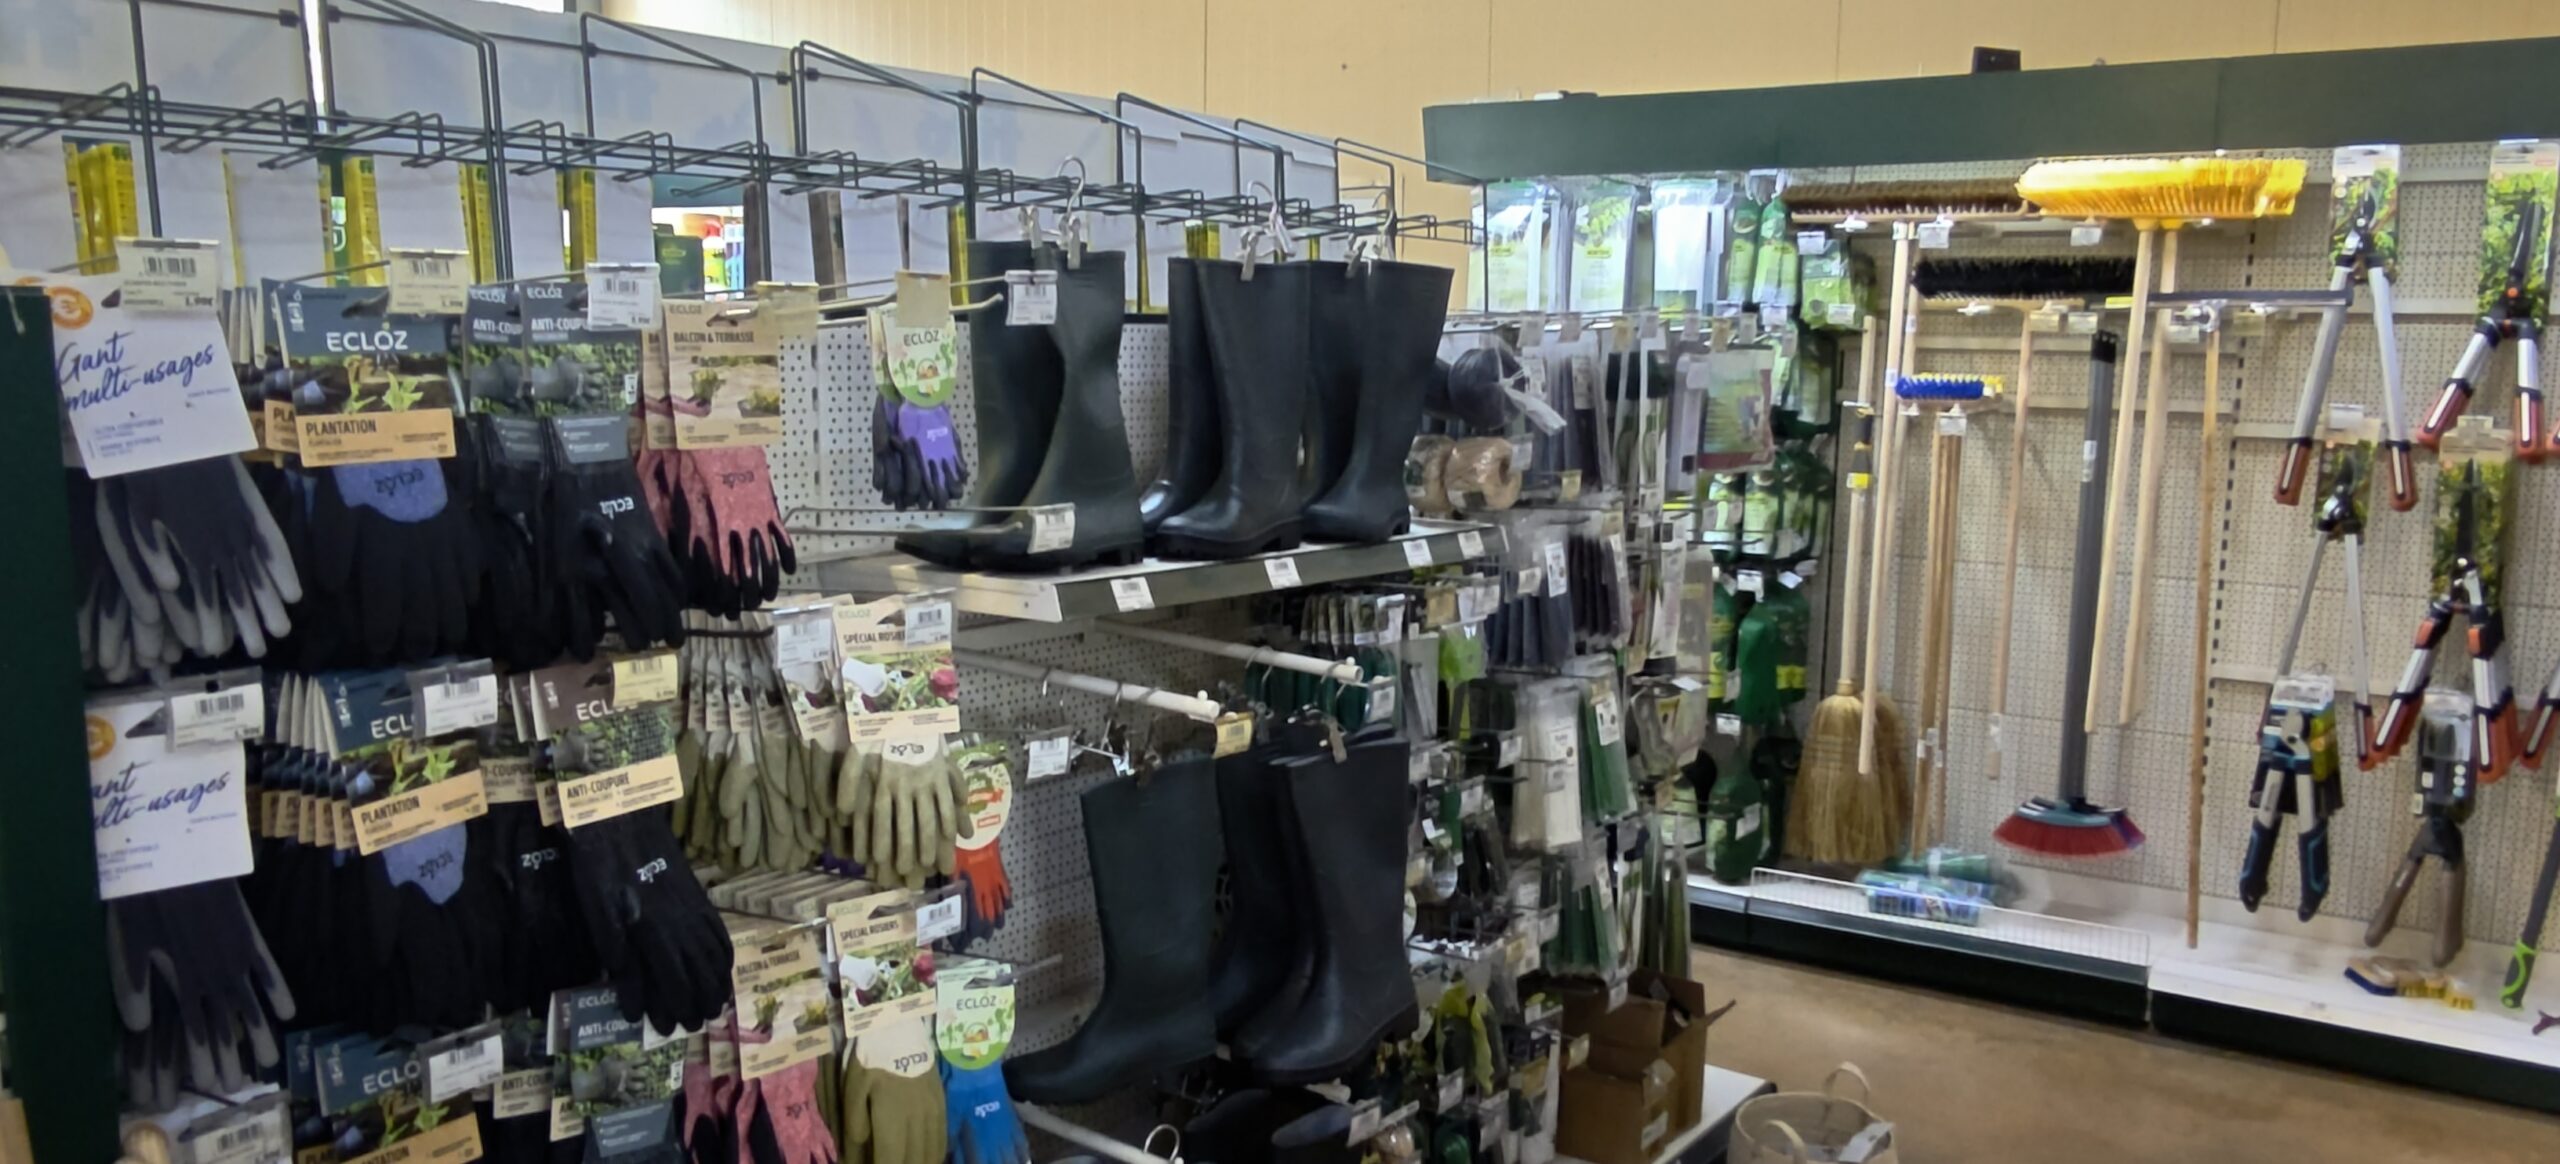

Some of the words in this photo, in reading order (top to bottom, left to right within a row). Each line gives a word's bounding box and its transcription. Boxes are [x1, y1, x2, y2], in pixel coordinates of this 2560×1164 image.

[326, 331, 408, 352] ECLOZ
[673, 331, 706, 343] BALCON
[715, 331, 755, 343] TERRASSE
[903, 330, 940, 347] ECLOZ
[57, 331, 134, 385] Gant
[64, 344, 214, 411] multi-usages
[306, 419, 377, 437] PLANTATION
[576, 698, 638, 721] ECL
[371, 713, 414, 738] ECL
[91, 761, 153, 799] ant
[567, 772, 631, 799] ANTI-COUPURE
[361, 795, 420, 825] PLANTATION
[956, 995, 997, 1011] ECLOZ
[362, 1060, 421, 1095] ECLO
